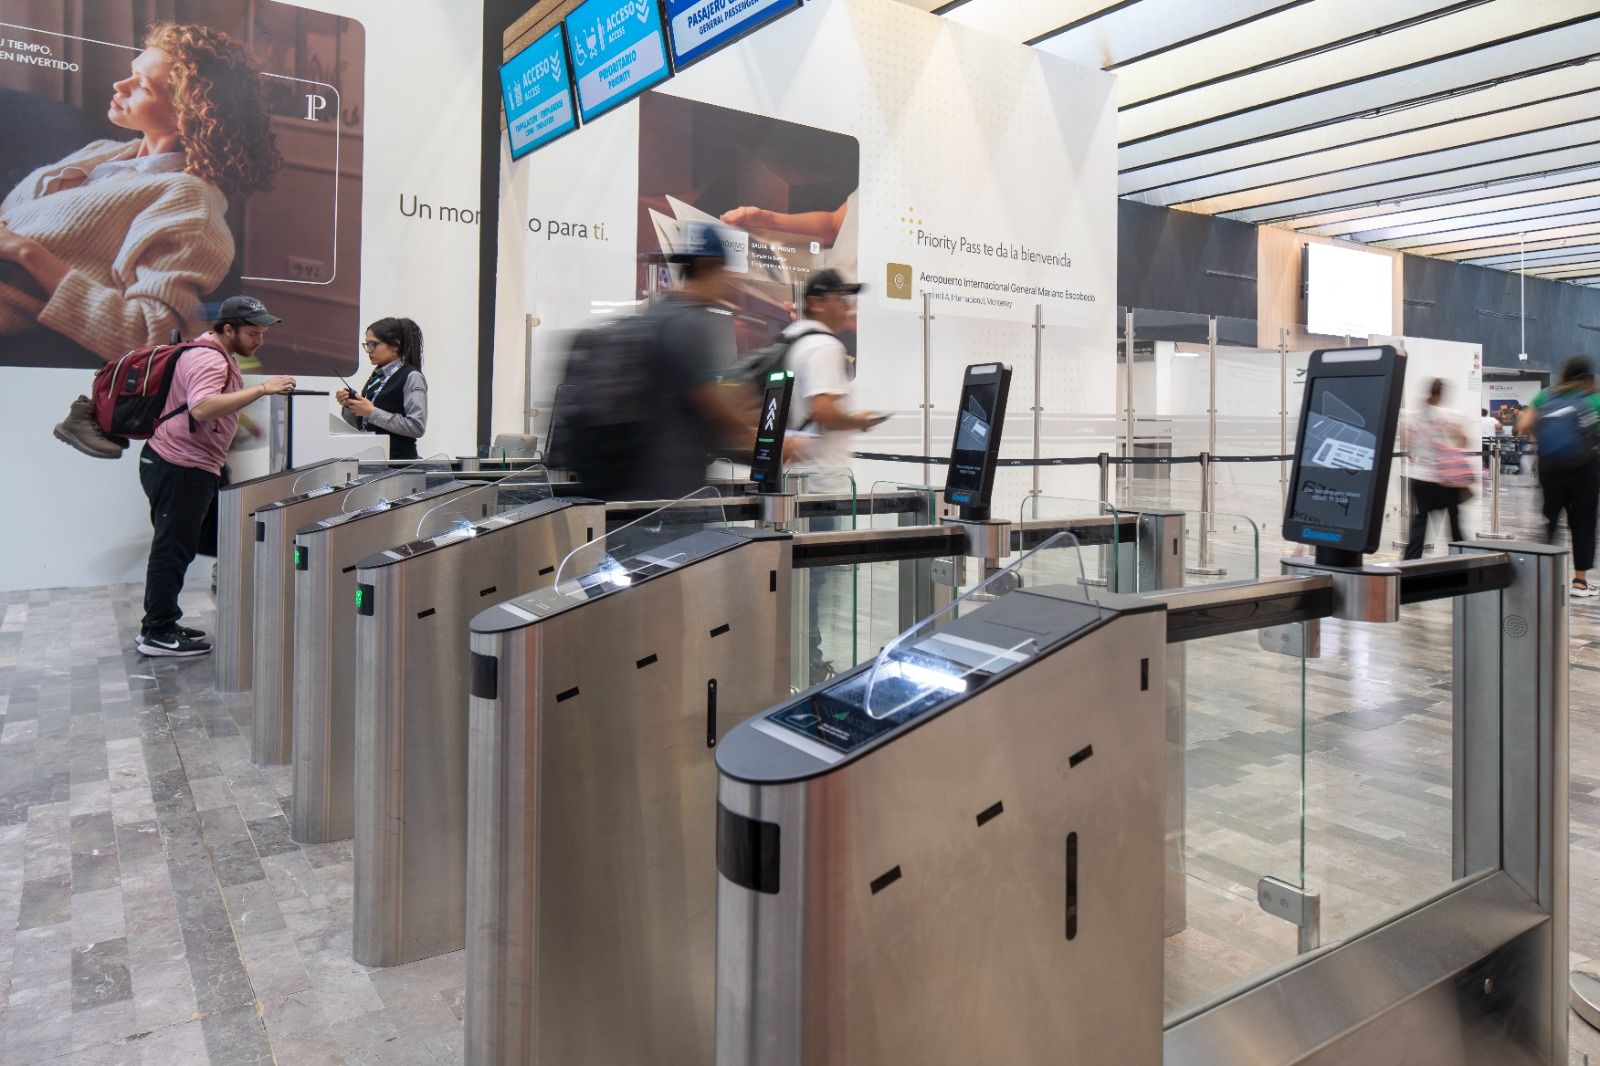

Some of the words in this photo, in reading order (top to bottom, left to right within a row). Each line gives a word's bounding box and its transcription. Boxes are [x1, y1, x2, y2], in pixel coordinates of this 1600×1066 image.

[606, 1, 635, 32] ACCESO
[687, 0, 726, 28] PASAJERO
[699, 14, 724, 35] GENERAL
[608, 26, 626, 43] ACCESS
[16, 53, 79, 72] INVERTIDO
[522, 57, 550, 88] ACCESO
[598, 50, 637, 81] PRIORITARIO
[608, 69, 631, 89] PRIORITY
[399, 193, 432, 220] Un
[548, 220, 588, 241] para
[593, 222, 609, 241] ti.
[917, 229, 957, 255] Priority
[960, 236, 981, 255] Pass
[983, 242, 994, 256] te
[996, 242, 1008, 259] da
[1010, 243, 1019, 260] la
[1021, 246, 1071, 268] bienvenida
[920, 271, 962, 287] Aeropuerto
[964, 277, 1009, 292] Internacional
[1010, 283, 1038, 295] General
[1038, 286, 1063, 298] Mariano
